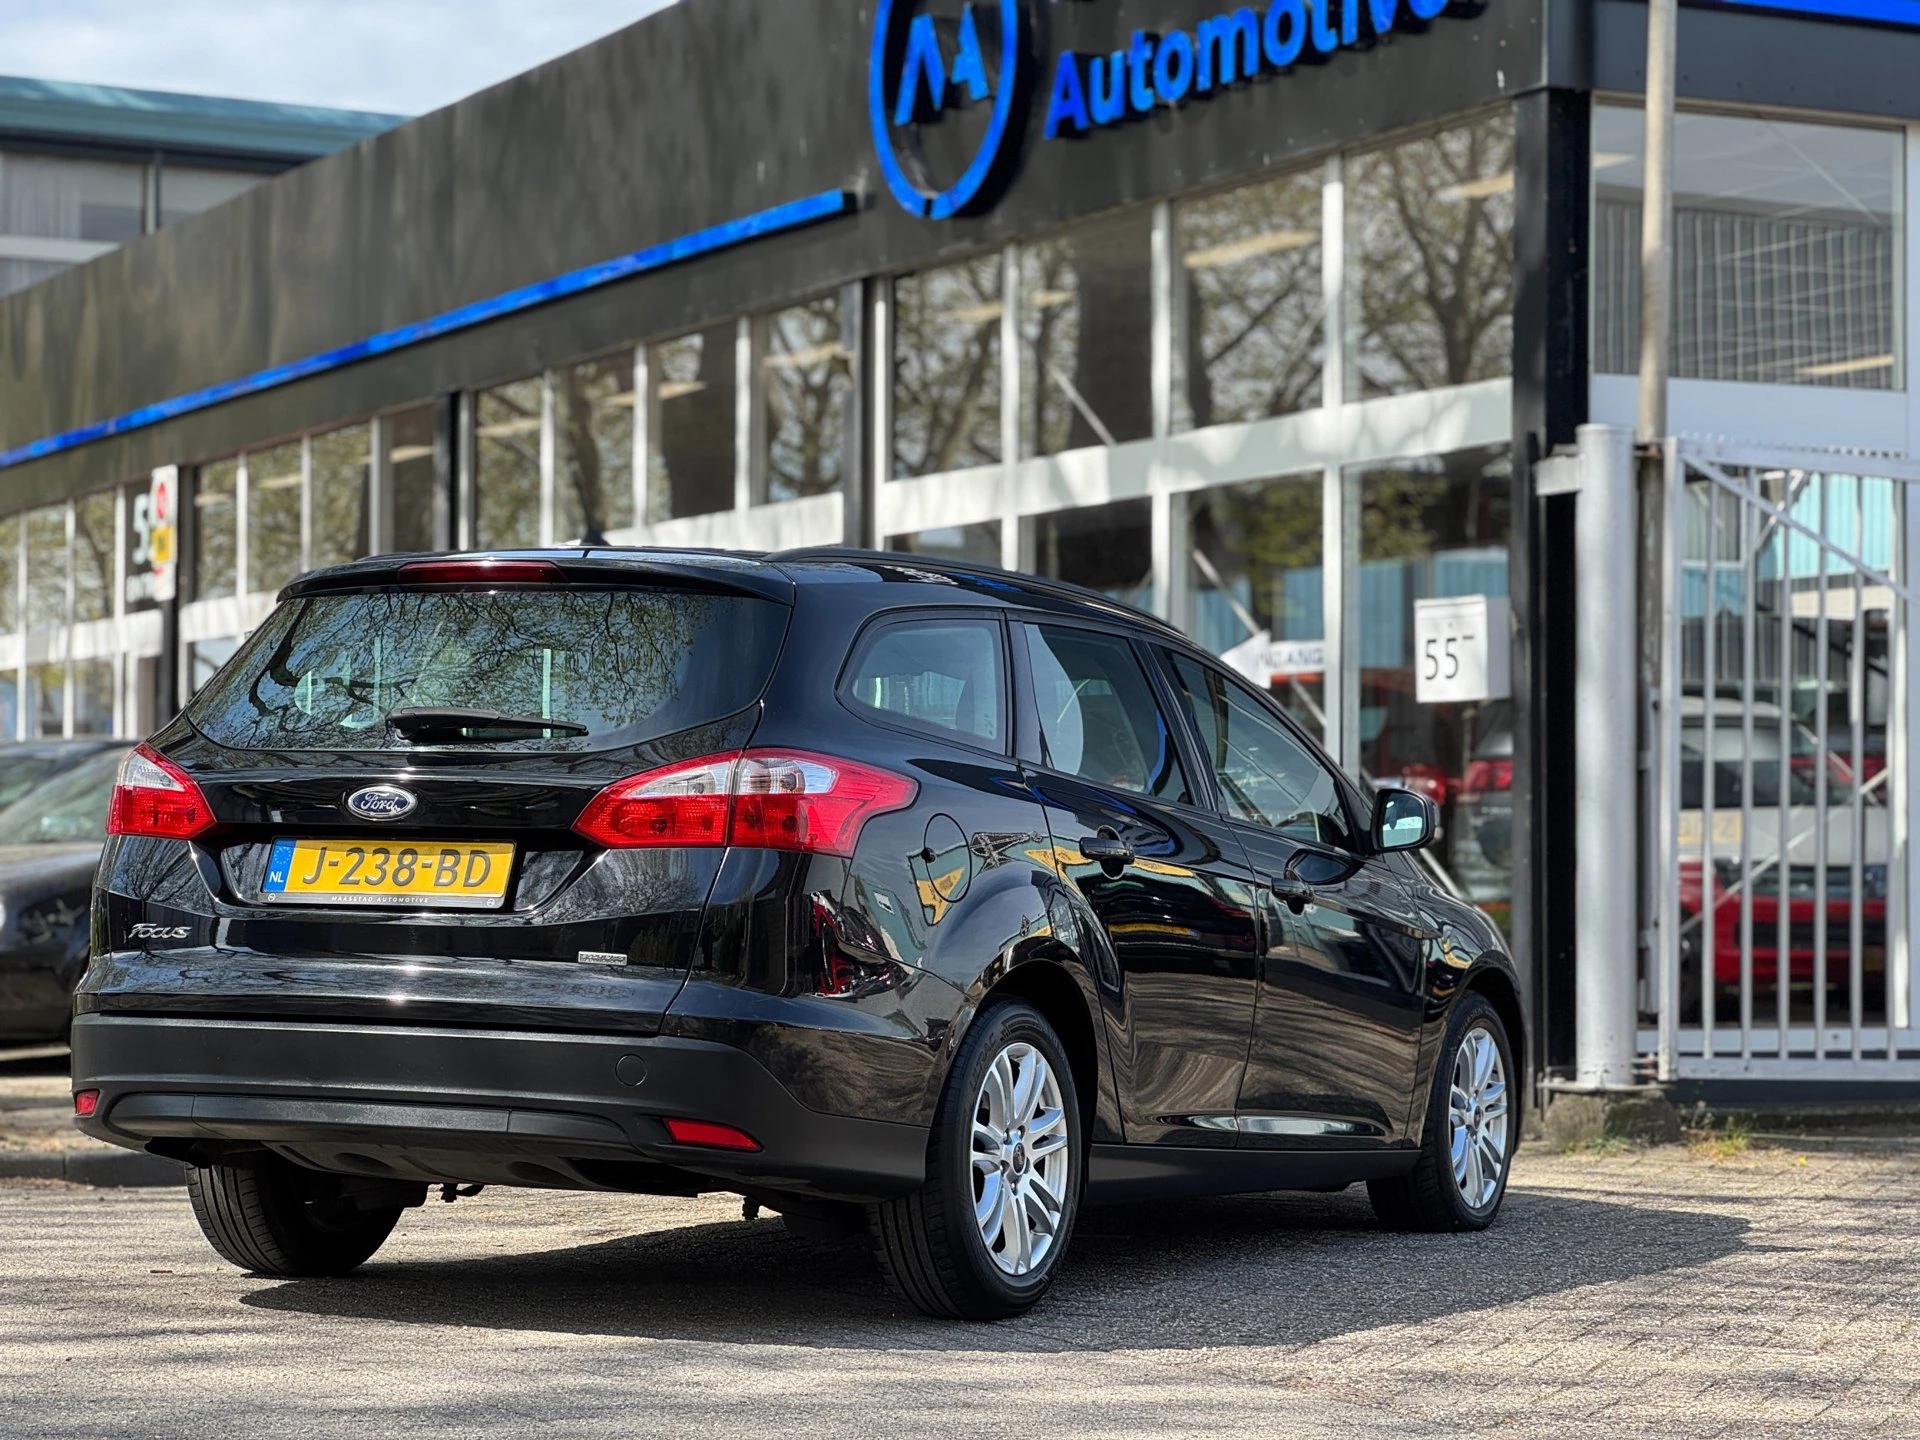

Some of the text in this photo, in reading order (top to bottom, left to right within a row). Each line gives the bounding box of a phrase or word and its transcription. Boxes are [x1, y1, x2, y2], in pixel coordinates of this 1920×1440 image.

[1043, 0, 1447, 138] Automotiv
[360, 791, 401, 810] Ford
[303, 846, 491, 887] J-238-BD
[268, 871, 284, 883] NL
[376, 896, 429, 904] AUTOMOTIVE
